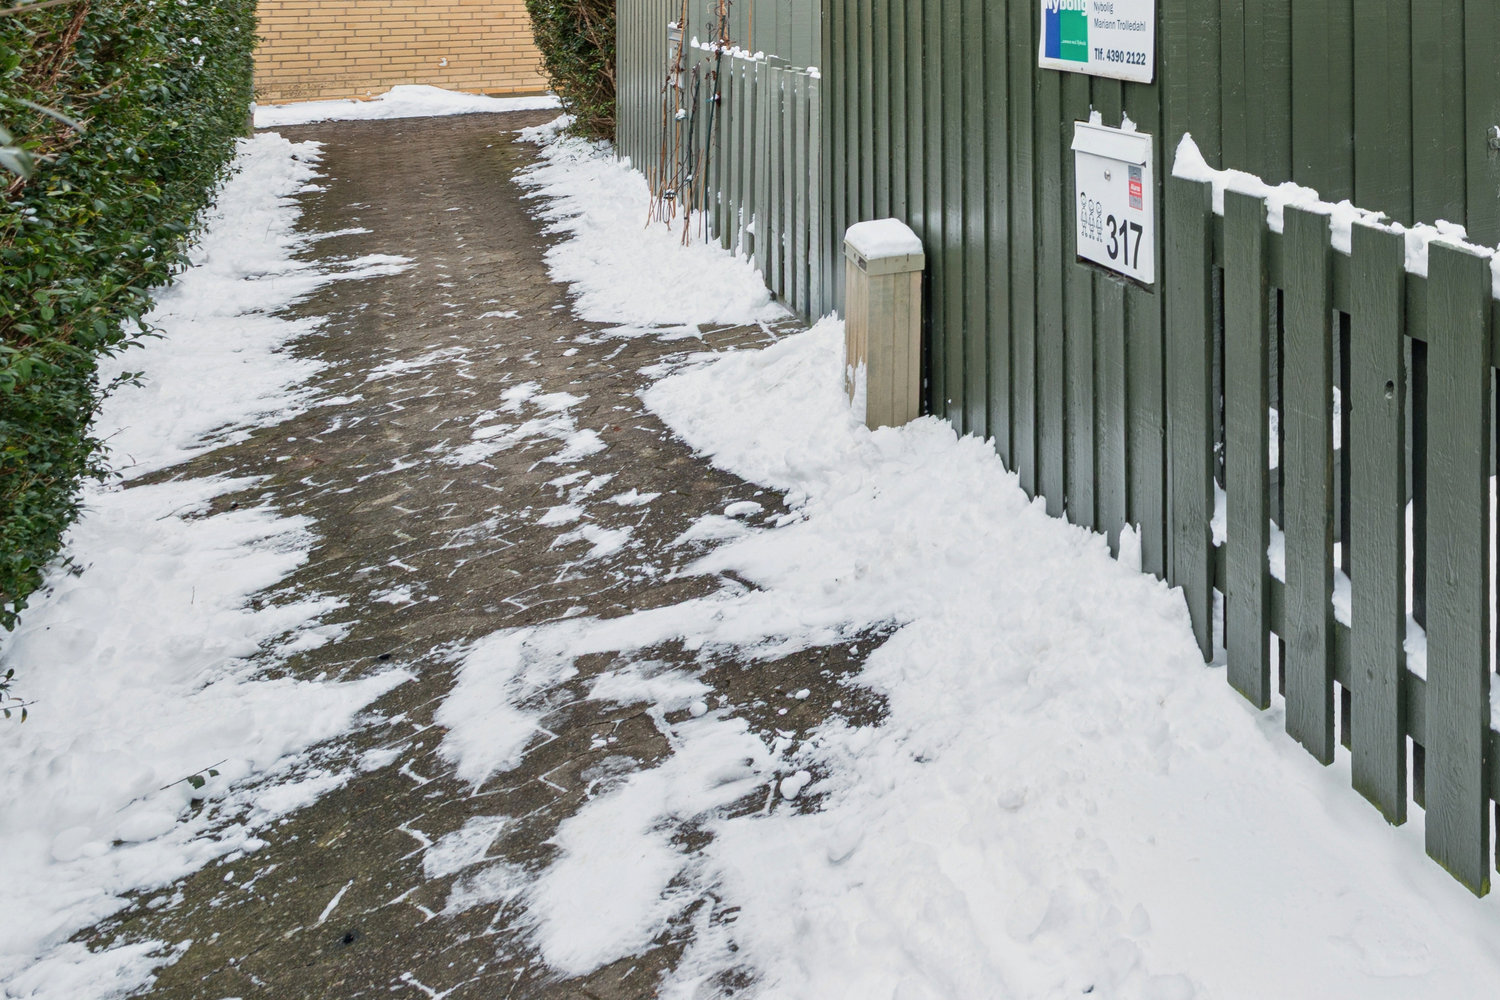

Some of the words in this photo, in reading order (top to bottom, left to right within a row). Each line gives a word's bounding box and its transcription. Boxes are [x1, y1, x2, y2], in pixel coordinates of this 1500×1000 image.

[1093, 1, 1114, 15] Nybolig
[1094, 18, 1116, 30] Mariann
[1117, 19, 1146, 32] Trolledahl
[1094, 48, 1105, 61] Tlf.
[1106, 49, 1125, 63] 4390
[1126, 52, 1146, 66] 2122
[1106, 214, 1143, 270] 317
